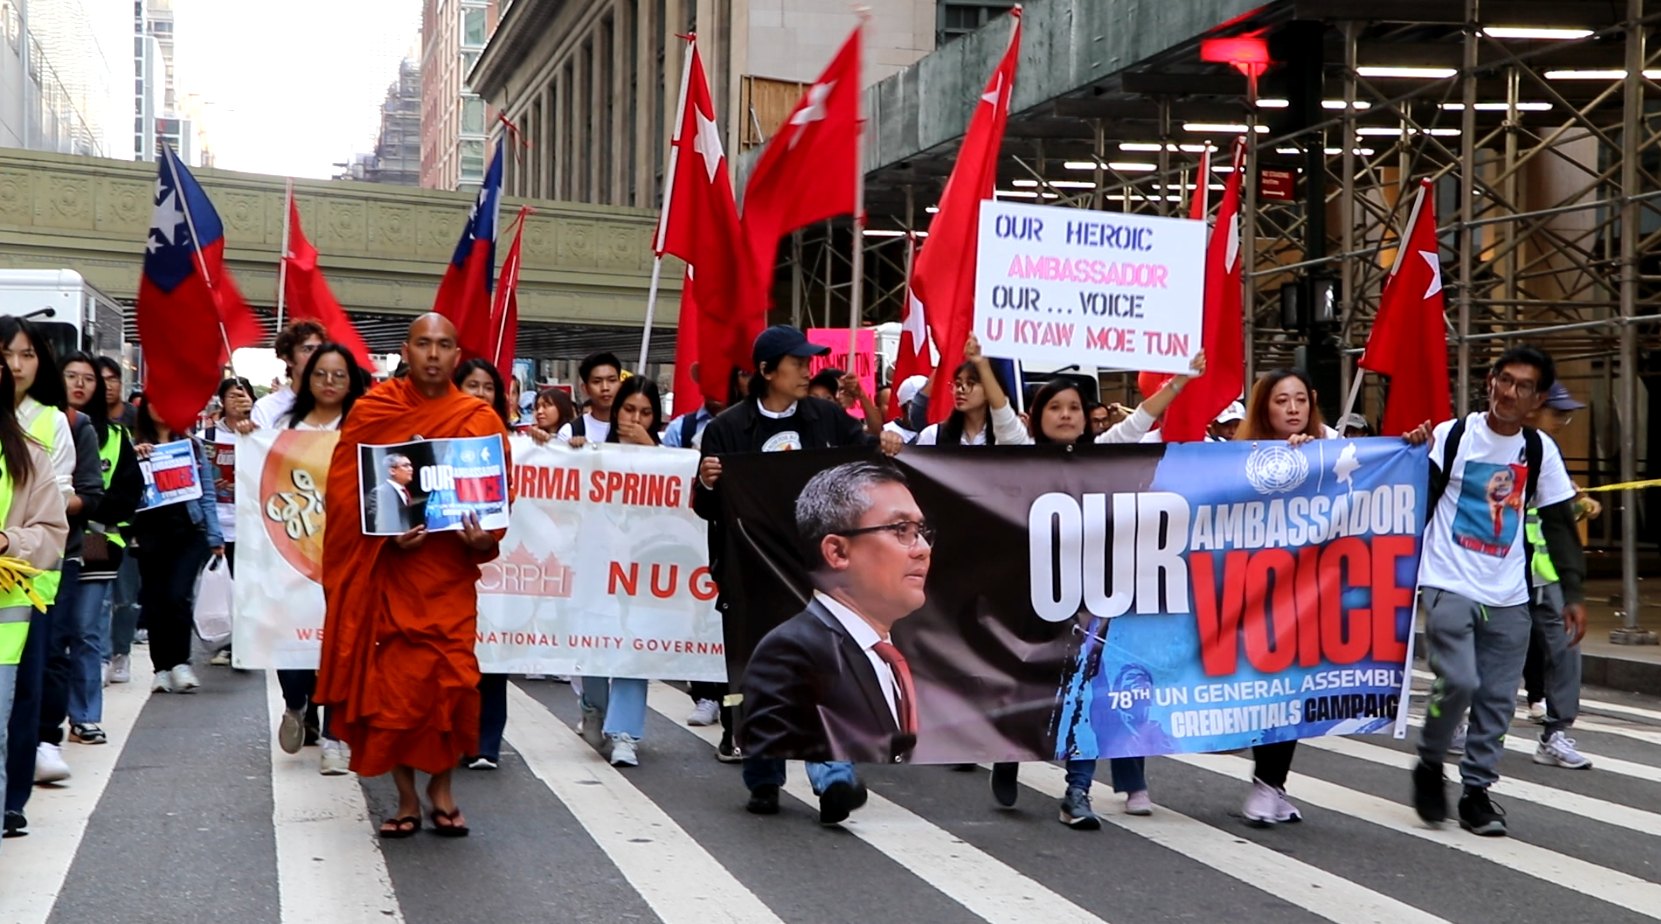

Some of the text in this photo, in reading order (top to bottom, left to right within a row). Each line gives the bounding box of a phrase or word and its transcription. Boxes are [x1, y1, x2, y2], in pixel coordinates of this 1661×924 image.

[995, 214, 1153, 251] OUR HEROIC
[1007, 254, 1168, 288] AMBASSADOR
[1079, 291, 1144, 319] VOICE
[986, 317, 1189, 357] U KYAW MOE TUN
[419, 464, 456, 493] OUR
[588, 470, 682, 508] SPRING
[1190, 484, 1416, 551] AMBASSADOR
[1028, 491, 1190, 622] OUR
[478, 563, 565, 594] CRPH
[607, 561, 719, 601] NUG
[1189, 536, 1415, 677] VOICE
[475, 631, 723, 655] NATIONAL UNITY GOVERNM
[1108, 688, 1150, 710] 78TH
[1155, 686, 1188, 707] UN
[1194, 678, 1296, 703] GENERAL
[1171, 700, 1302, 738] CREDENTIALS
